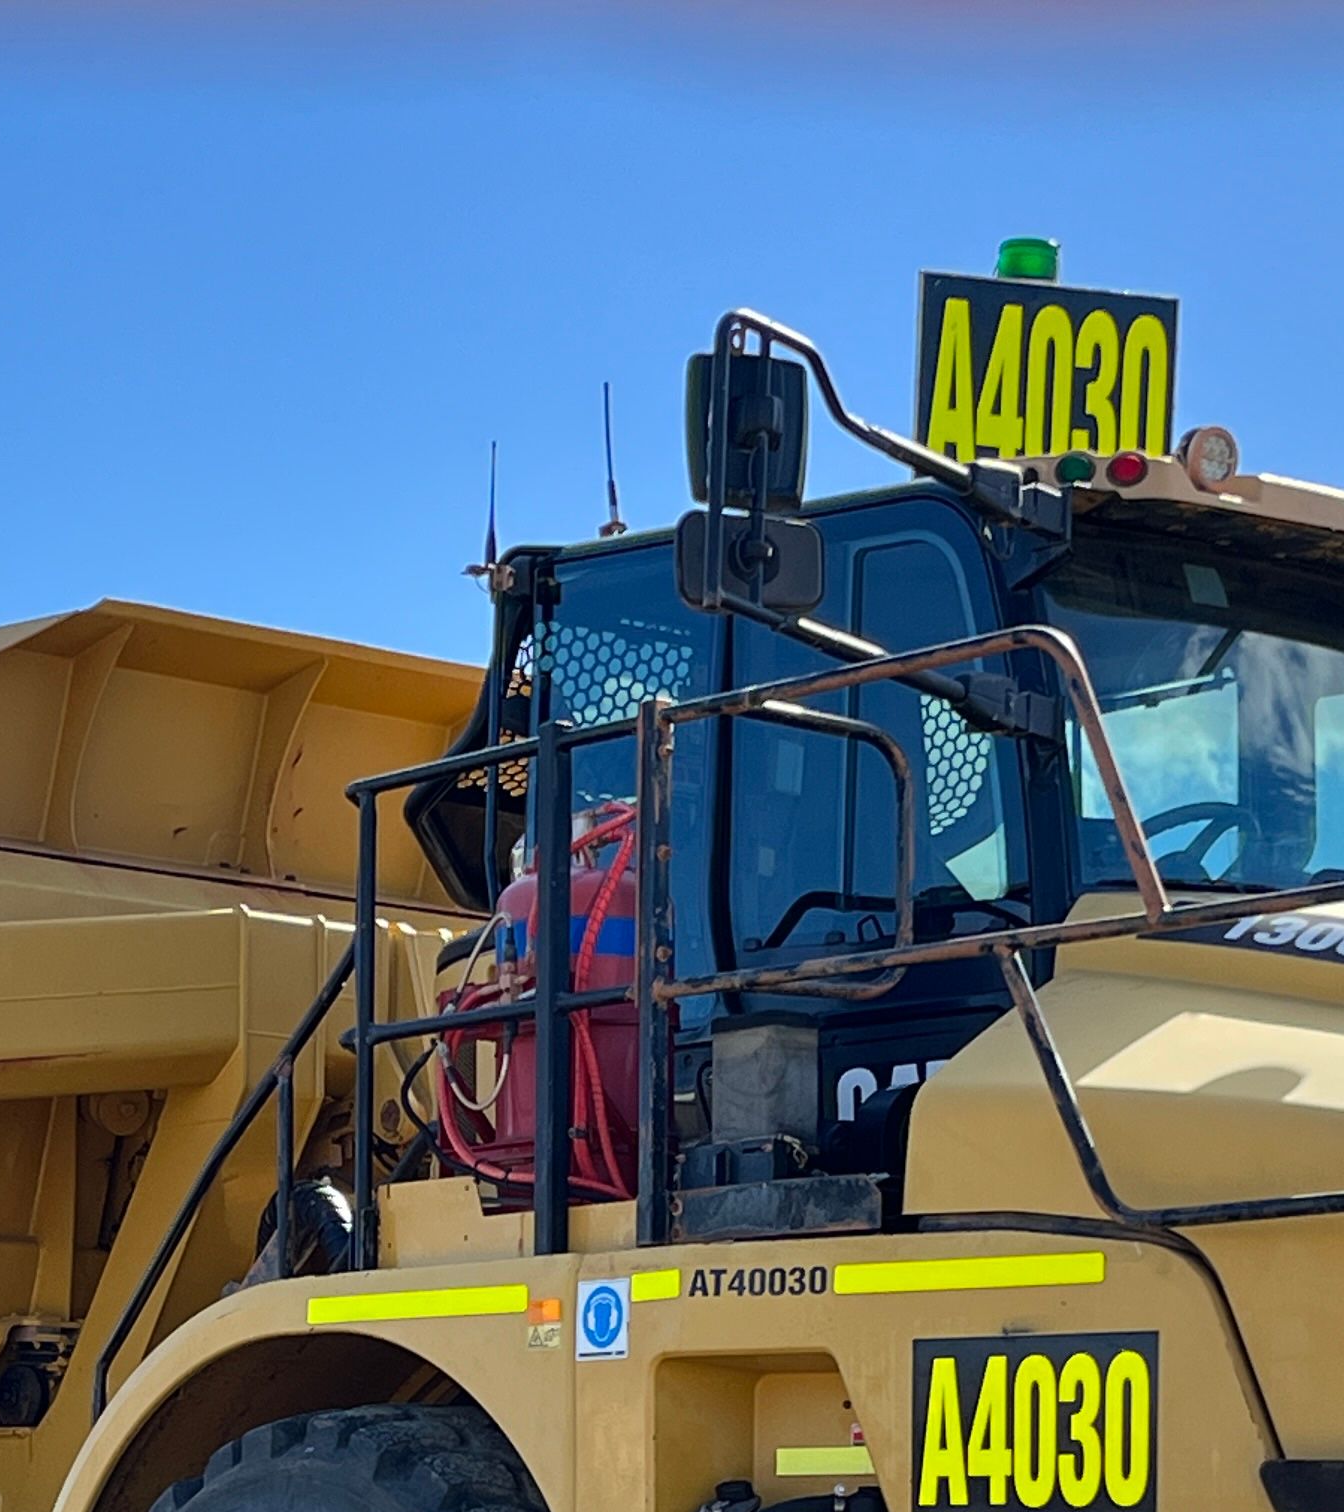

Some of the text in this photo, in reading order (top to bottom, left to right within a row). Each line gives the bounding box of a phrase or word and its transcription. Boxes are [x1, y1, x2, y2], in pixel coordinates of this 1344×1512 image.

[926, 297, 1169, 463] A4030
[688, 1266, 828, 1298] AT40030
[918, 1349, 1151, 1509] A4030
